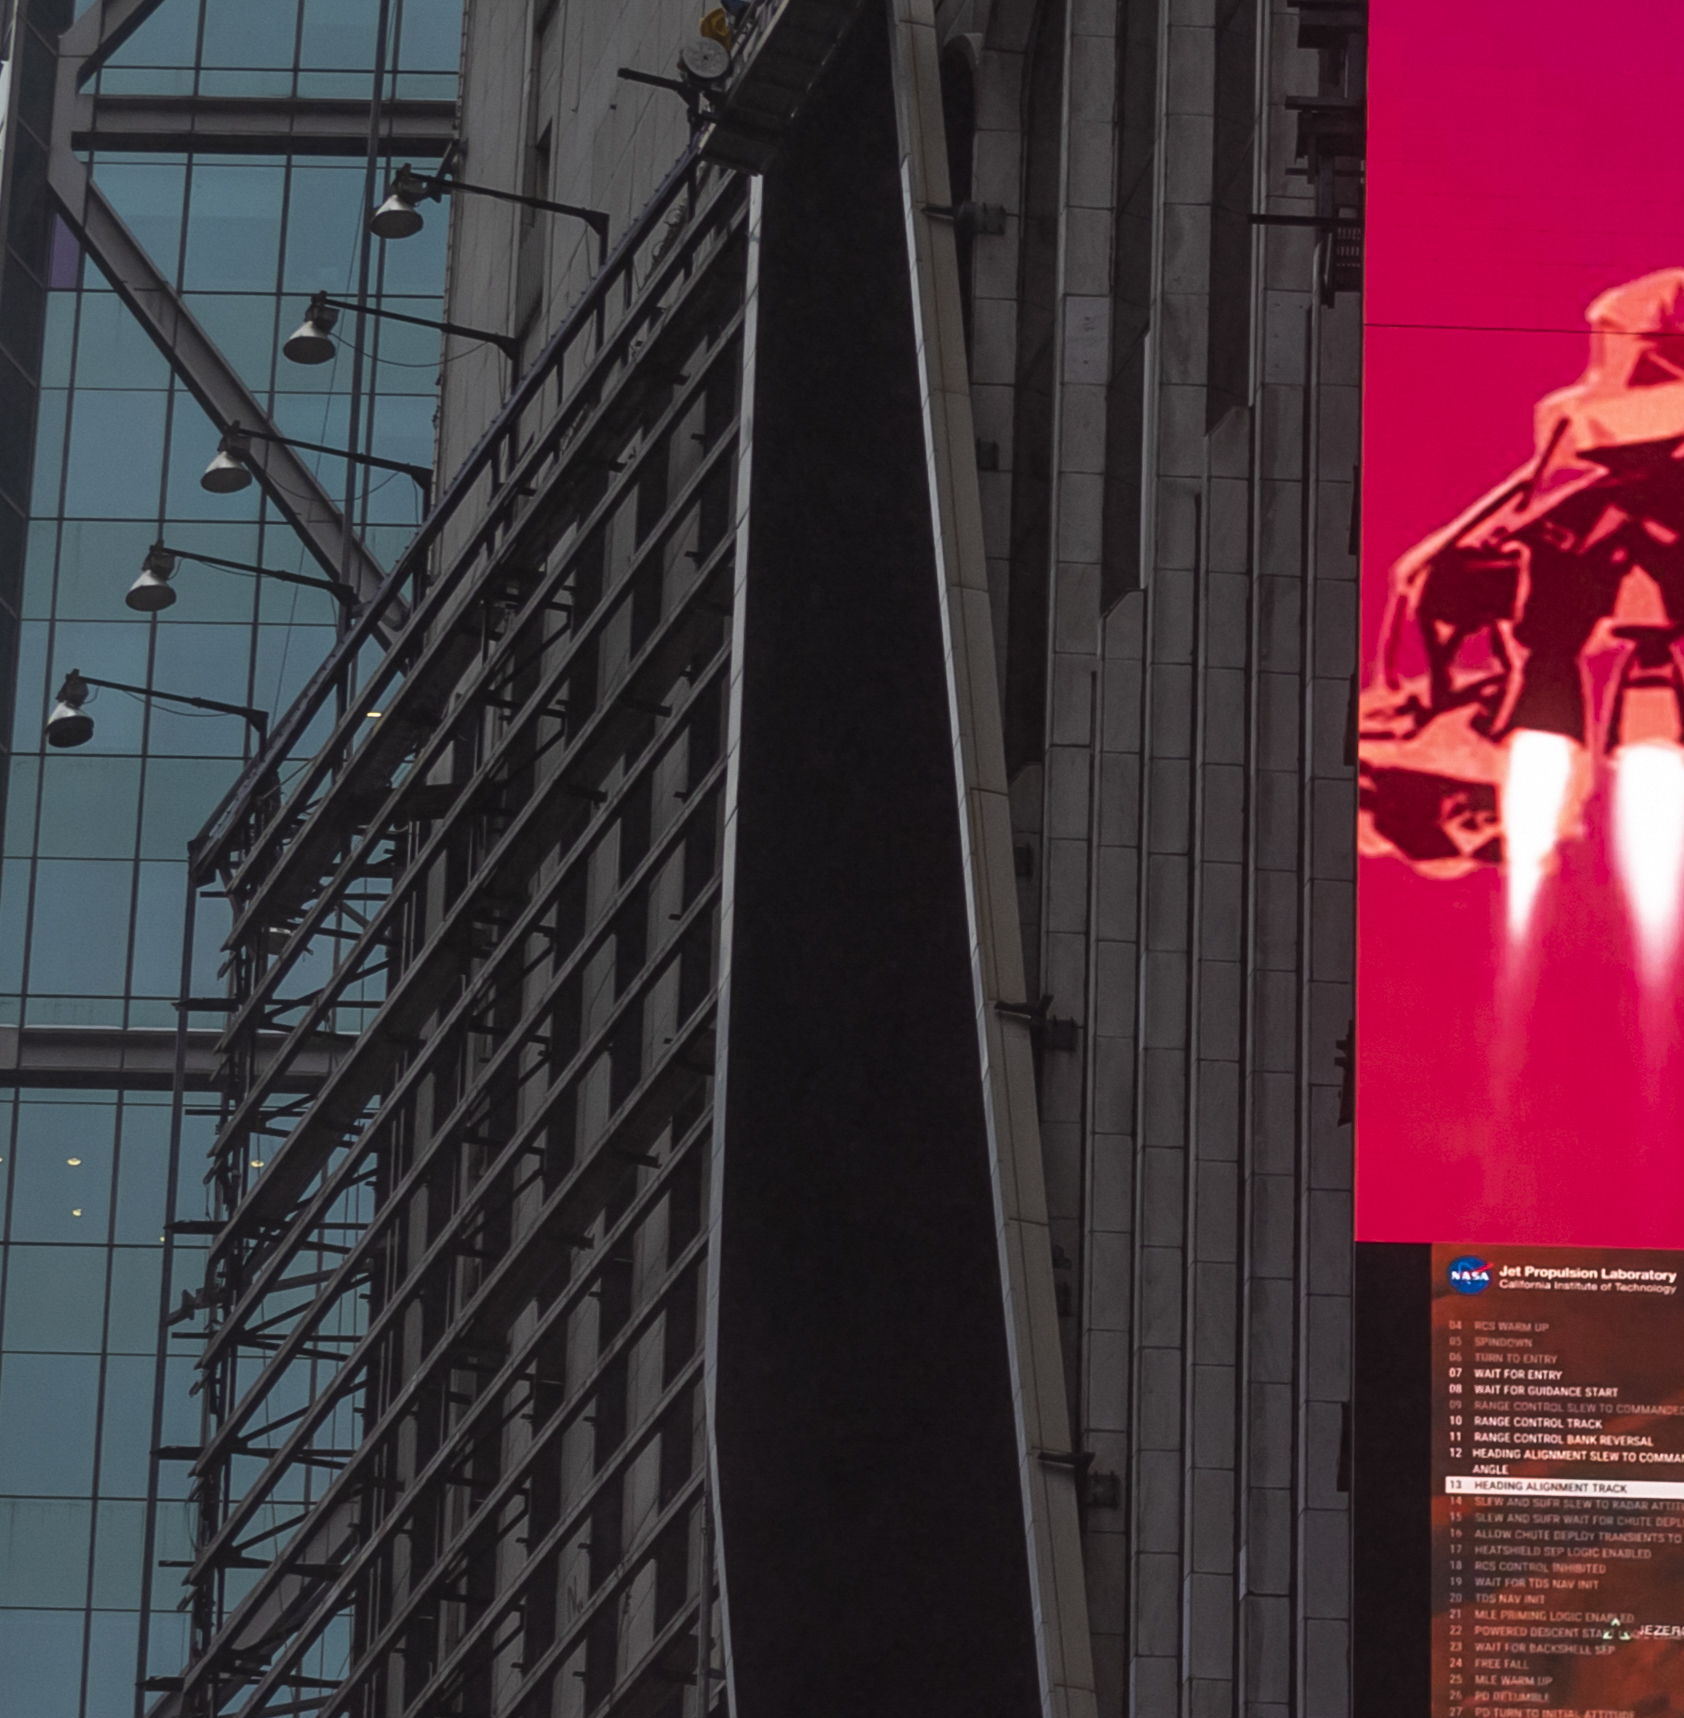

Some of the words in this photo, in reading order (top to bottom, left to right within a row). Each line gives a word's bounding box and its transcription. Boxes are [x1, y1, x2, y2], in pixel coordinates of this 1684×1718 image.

[1450, 1271, 1491, 1281] NASA
[1499, 1264, 1521, 1278] Jet
[1525, 1266, 1598, 1281] Propulsion
[1601, 1268, 1677, 1283] Laboratory
[1499, 1279, 1551, 1290] California
[1554, 1281, 1597, 1291] Institute
[1601, 1281, 1612, 1291] of
[1615, 1283, 1677, 1294] Technology
[1449, 1368, 1462, 1379] 07
[1474, 1368, 1501, 1380] WAIT
[1504, 1369, 1525, 1381] FOR
[1527, 1369, 1563, 1381] ENTRY
[1449, 1383, 1462, 1395] 08
[1474, 1384, 1501, 1396] WAIT
[1504, 1385, 1525, 1396] FOR
[1527, 1385, 1582, 1398] GUIDANCE
[1585, 1386, 1618, 1398] START
[1449, 1415, 1462, 1427] 10
[1474, 1416, 1511, 1428] RANGE
[1513, 1417, 1565, 1429] CONTROL
[1567, 1418, 1603, 1430] TRACK
[1449, 1431, 1461, 1443] 11
[1474, 1432, 1511, 1444] RANGE
[1513, 1433, 1564, 1445] CONTROL
[1567, 1434, 1598, 1446] BANK
[1600, 1435, 1654, 1447] REVERSAL
[1449, 1447, 1462, 1459] 12
[1472, 1448, 1521, 1460] HEADING
[1523, 1449, 1587, 1462] ALIGNMENT
[1589, 1451, 1619, 1463] SLEW
[1622, 1452, 1636, 1463] TO
[1472, 1464, 1509, 1476] ANGLE
[1450, 1479, 1462, 1491] 13
[1475, 1480, 1523, 1492] HEADING
[1526, 1481, 1590, 1494] ALIGNMENT
[1592, 1483, 1627, 1495] TRACK
[1450, 1657, 1462, 1669] 24
[1475, 1658, 1501, 1670] FREE
[1504, 1658, 1529, 1670] FALL
